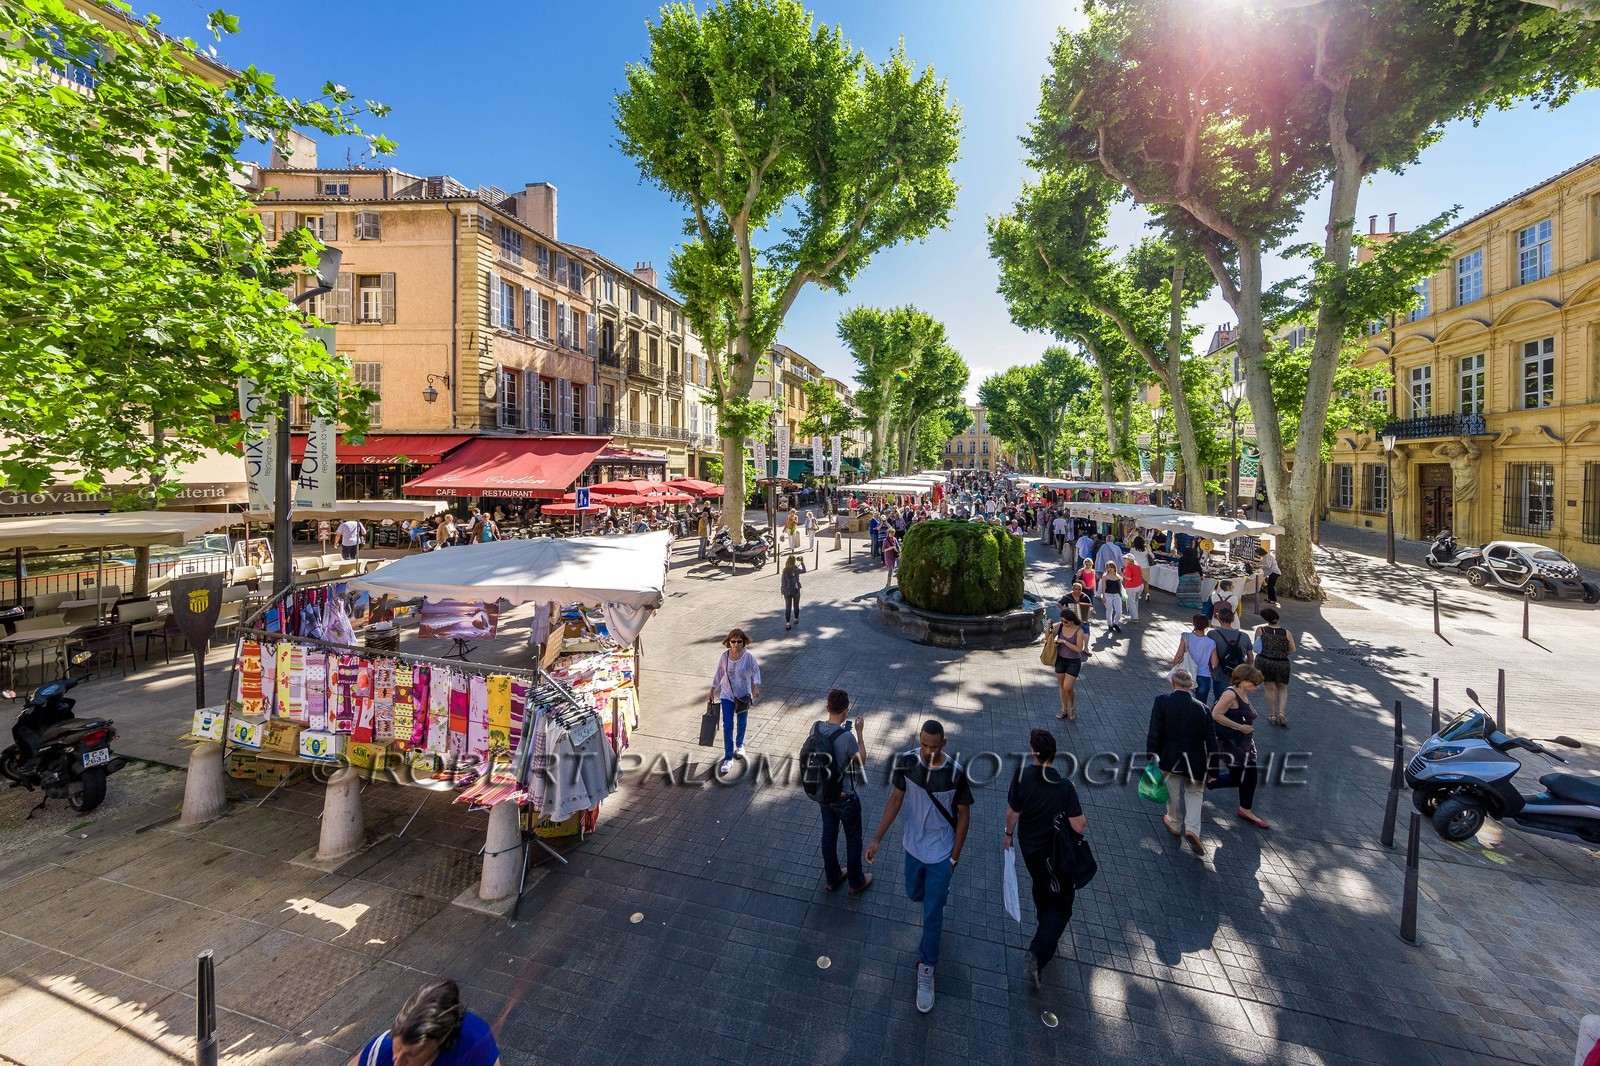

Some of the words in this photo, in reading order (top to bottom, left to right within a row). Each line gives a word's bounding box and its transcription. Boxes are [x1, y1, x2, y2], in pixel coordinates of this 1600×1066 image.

[361, 456, 419, 464] Grilln
[137, 484, 225, 500] Gateria
[482, 489, 534, 498] RESTAURANT
